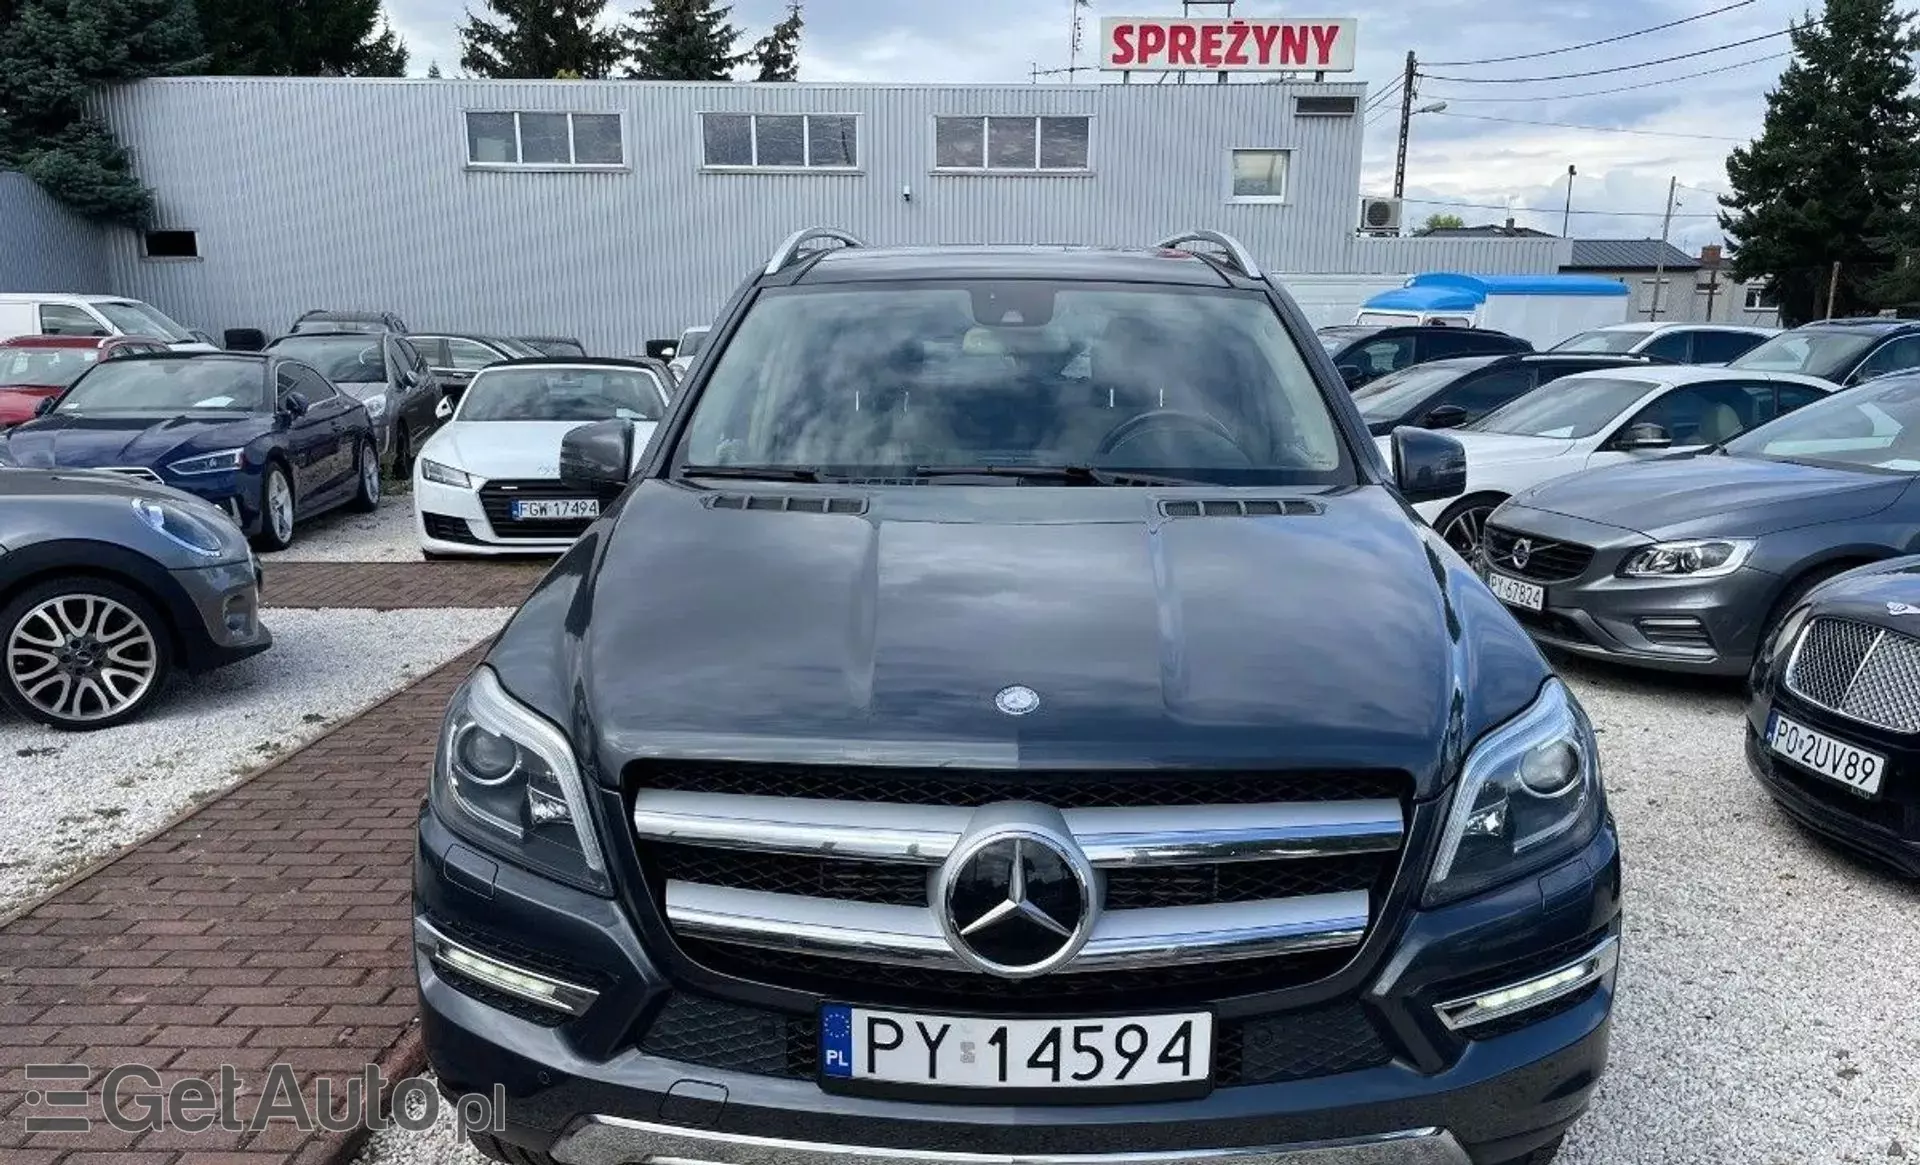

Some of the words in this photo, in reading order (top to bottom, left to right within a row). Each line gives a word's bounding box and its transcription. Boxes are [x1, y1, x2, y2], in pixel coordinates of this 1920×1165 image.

[1111, 20, 1340, 68] SPRĘŻYNY
[519, 501, 548, 517] FGW
[553, 501, 598, 516] 17494
[1506, 580, 1541, 608] 67824
[1801, 734, 1876, 786] 2UV89
[826, 1049, 849, 1067] PL
[866, 1016, 951, 1079] PY
[987, 1019, 1193, 1083] 14594
